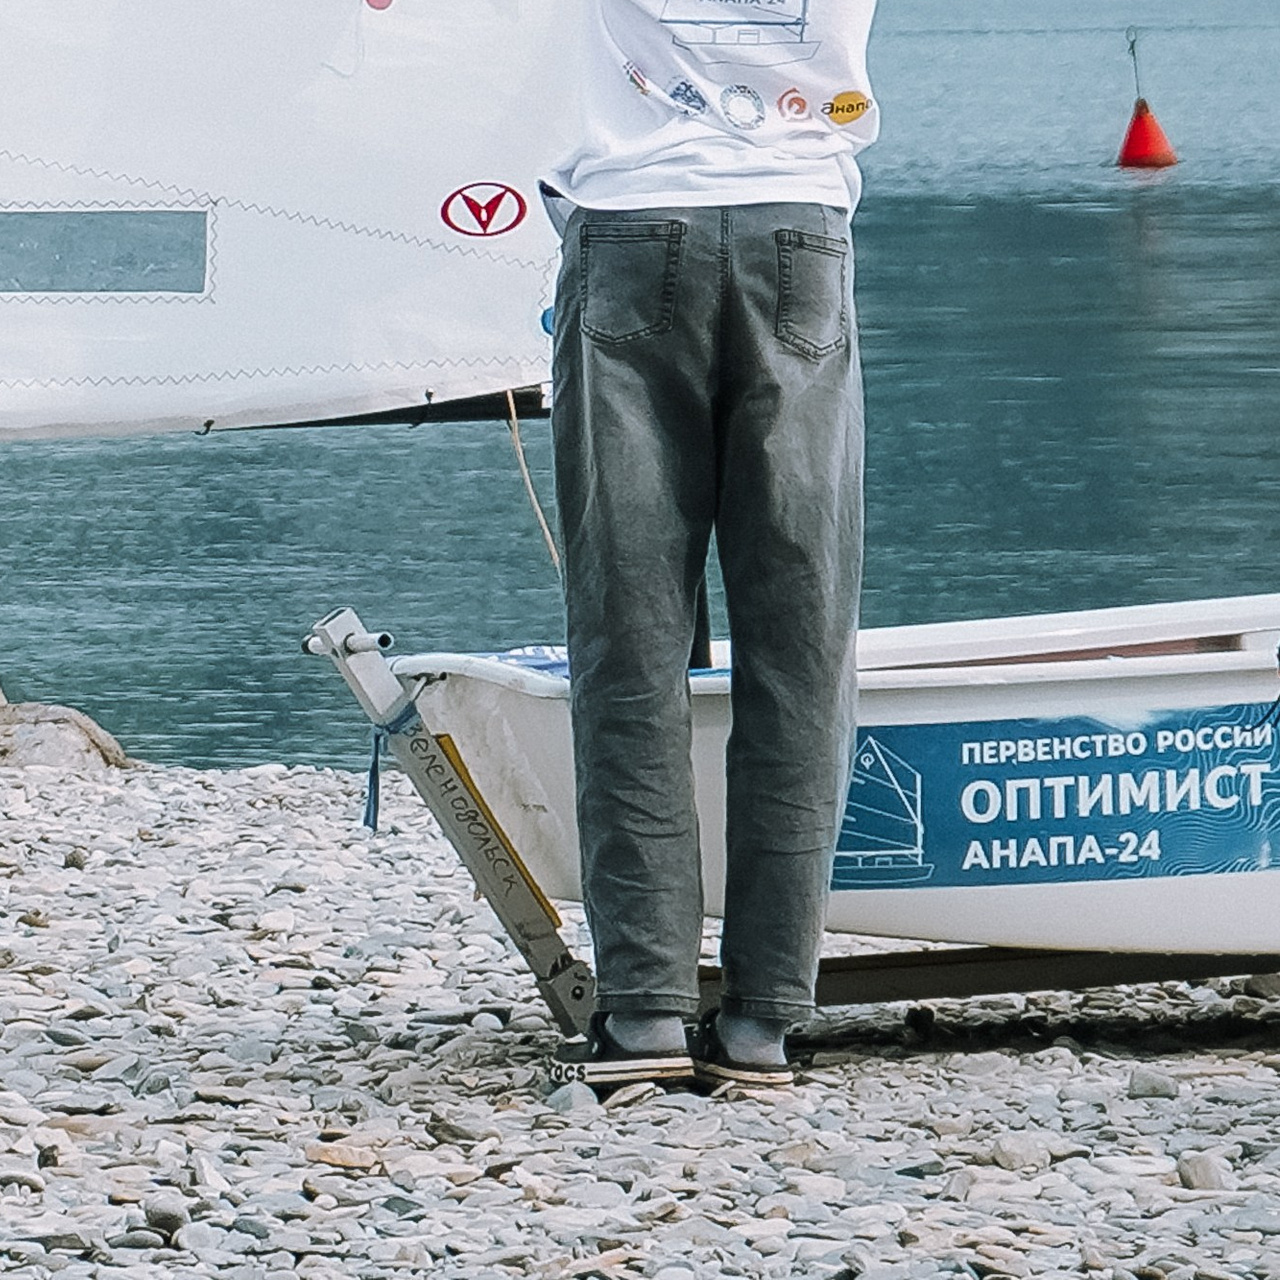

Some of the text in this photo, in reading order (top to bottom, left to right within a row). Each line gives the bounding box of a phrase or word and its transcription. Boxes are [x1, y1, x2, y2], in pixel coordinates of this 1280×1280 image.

[961, 722, 1273, 766] ПЕРВЕНСТВО РОССИИ
[959, 762, 1272, 825] ОПТИМИСТ
[961, 829, 1162, 871] АНАПА-24
